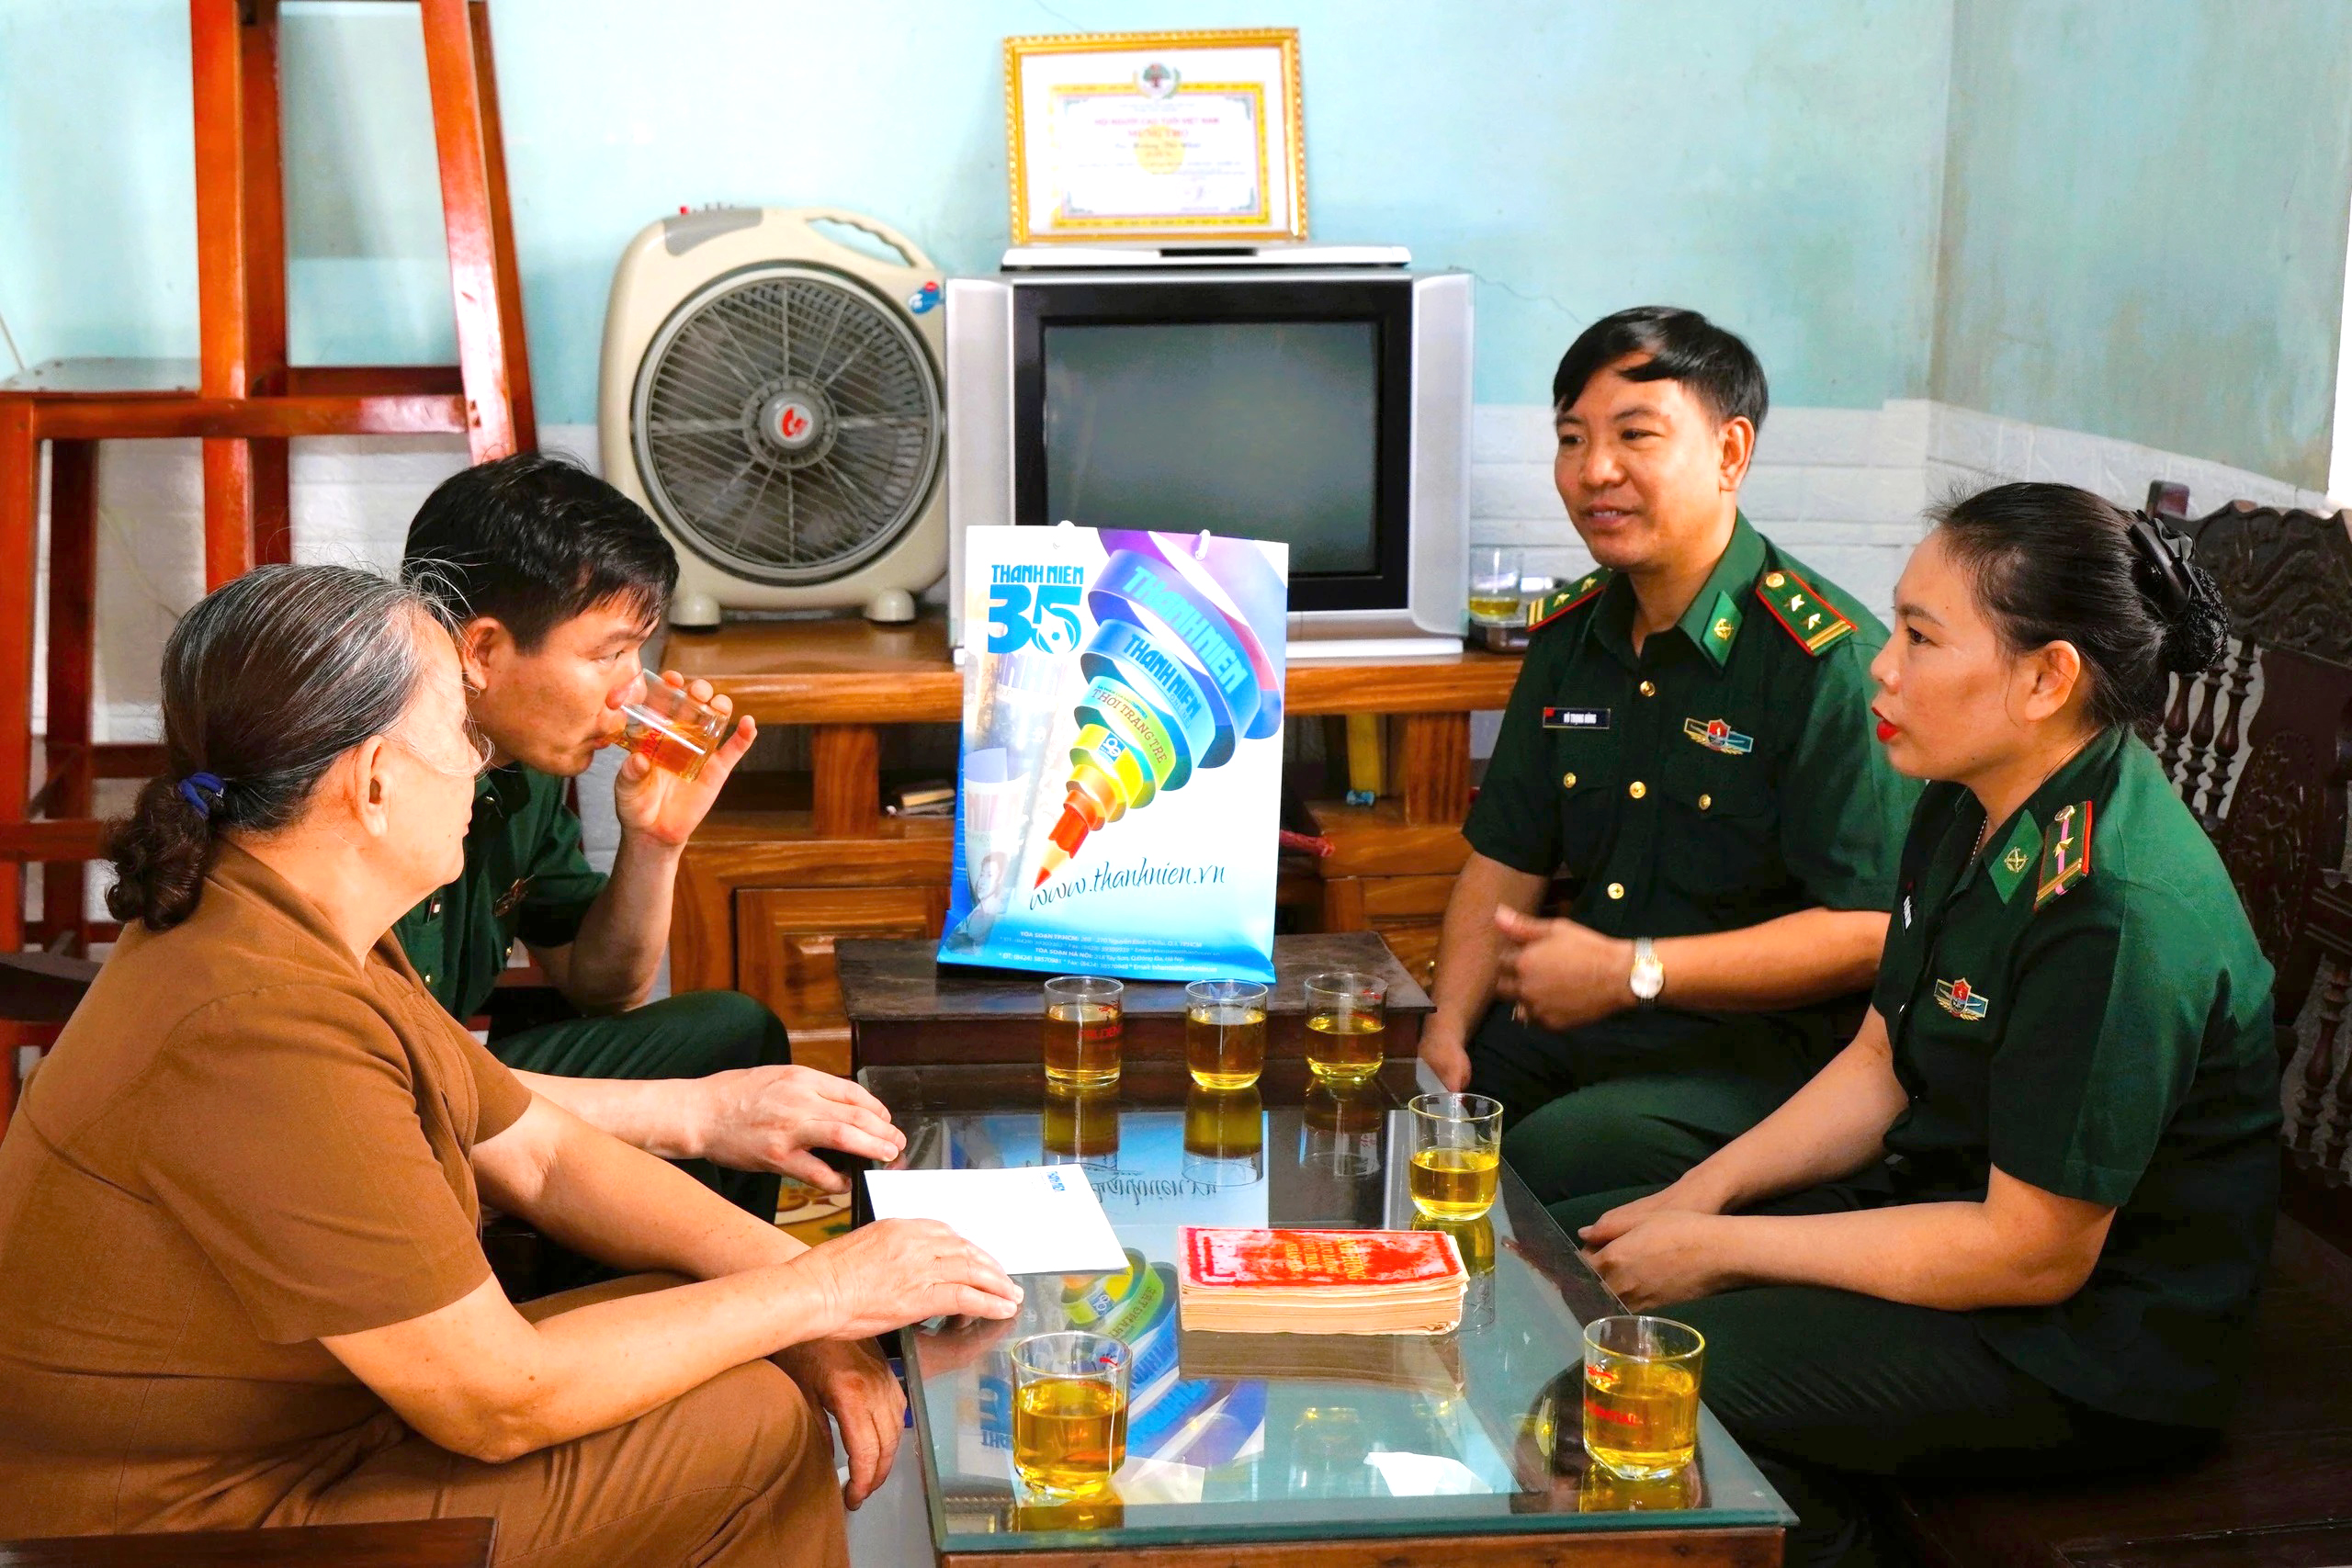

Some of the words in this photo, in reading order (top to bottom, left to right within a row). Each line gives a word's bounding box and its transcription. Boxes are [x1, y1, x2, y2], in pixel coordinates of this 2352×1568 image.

[991, 564, 1045, 583] THANH
[987, 584, 1083, 655] 35
[1122, 565, 1211, 646] THANH
[1123, 633, 1178, 688] THANH
[1119, 704, 1155, 741] TRANG
[1029, 857, 1226, 911] www.thanhnien.vn
